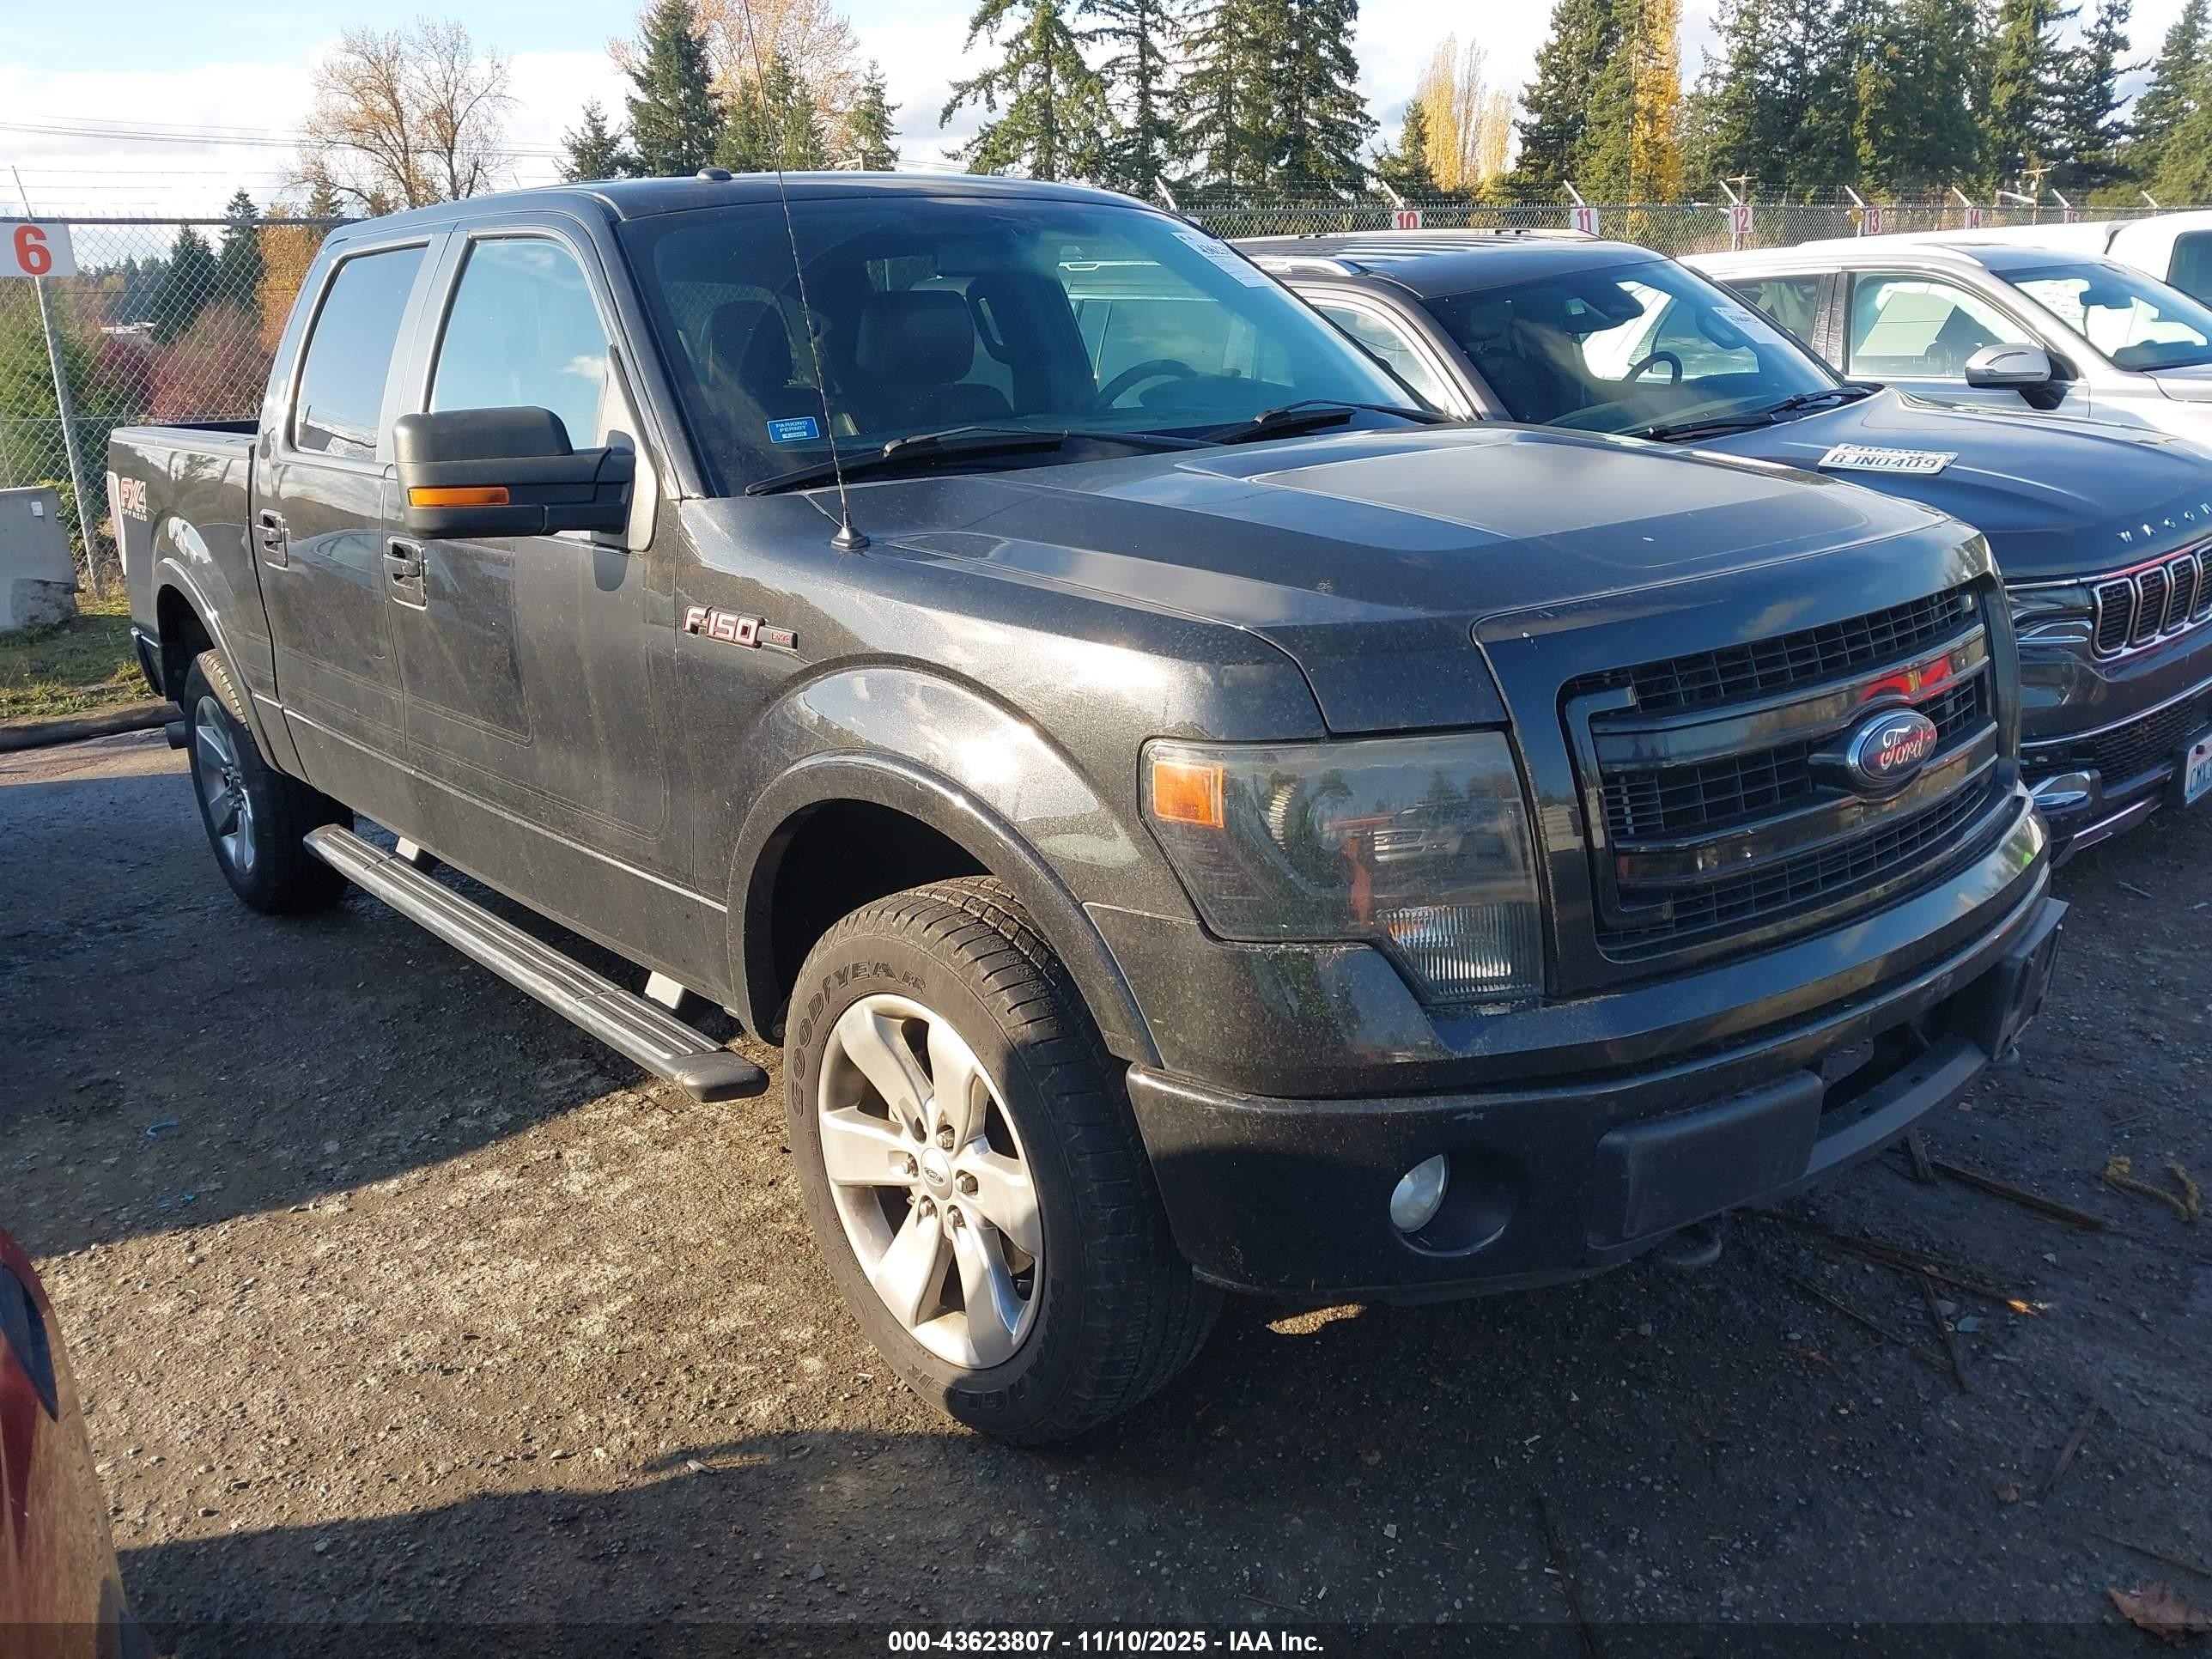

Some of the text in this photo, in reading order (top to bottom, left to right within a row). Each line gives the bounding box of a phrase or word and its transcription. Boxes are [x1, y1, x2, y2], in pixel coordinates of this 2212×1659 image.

[1396, 211, 1418, 228] 10
[1577, 209, 1592, 232] 11
[1733, 208, 1749, 232] 12
[1868, 210, 1880, 234] 13
[1970, 210, 1979, 228] 14
[13, 224, 52, 276] 6
[121, 477, 146, 514] FX4
[133, 511, 147, 521] ROAD
[1880, 724, 1924, 770] Ford
[792, 961, 927, 1117] GOODYEAR
